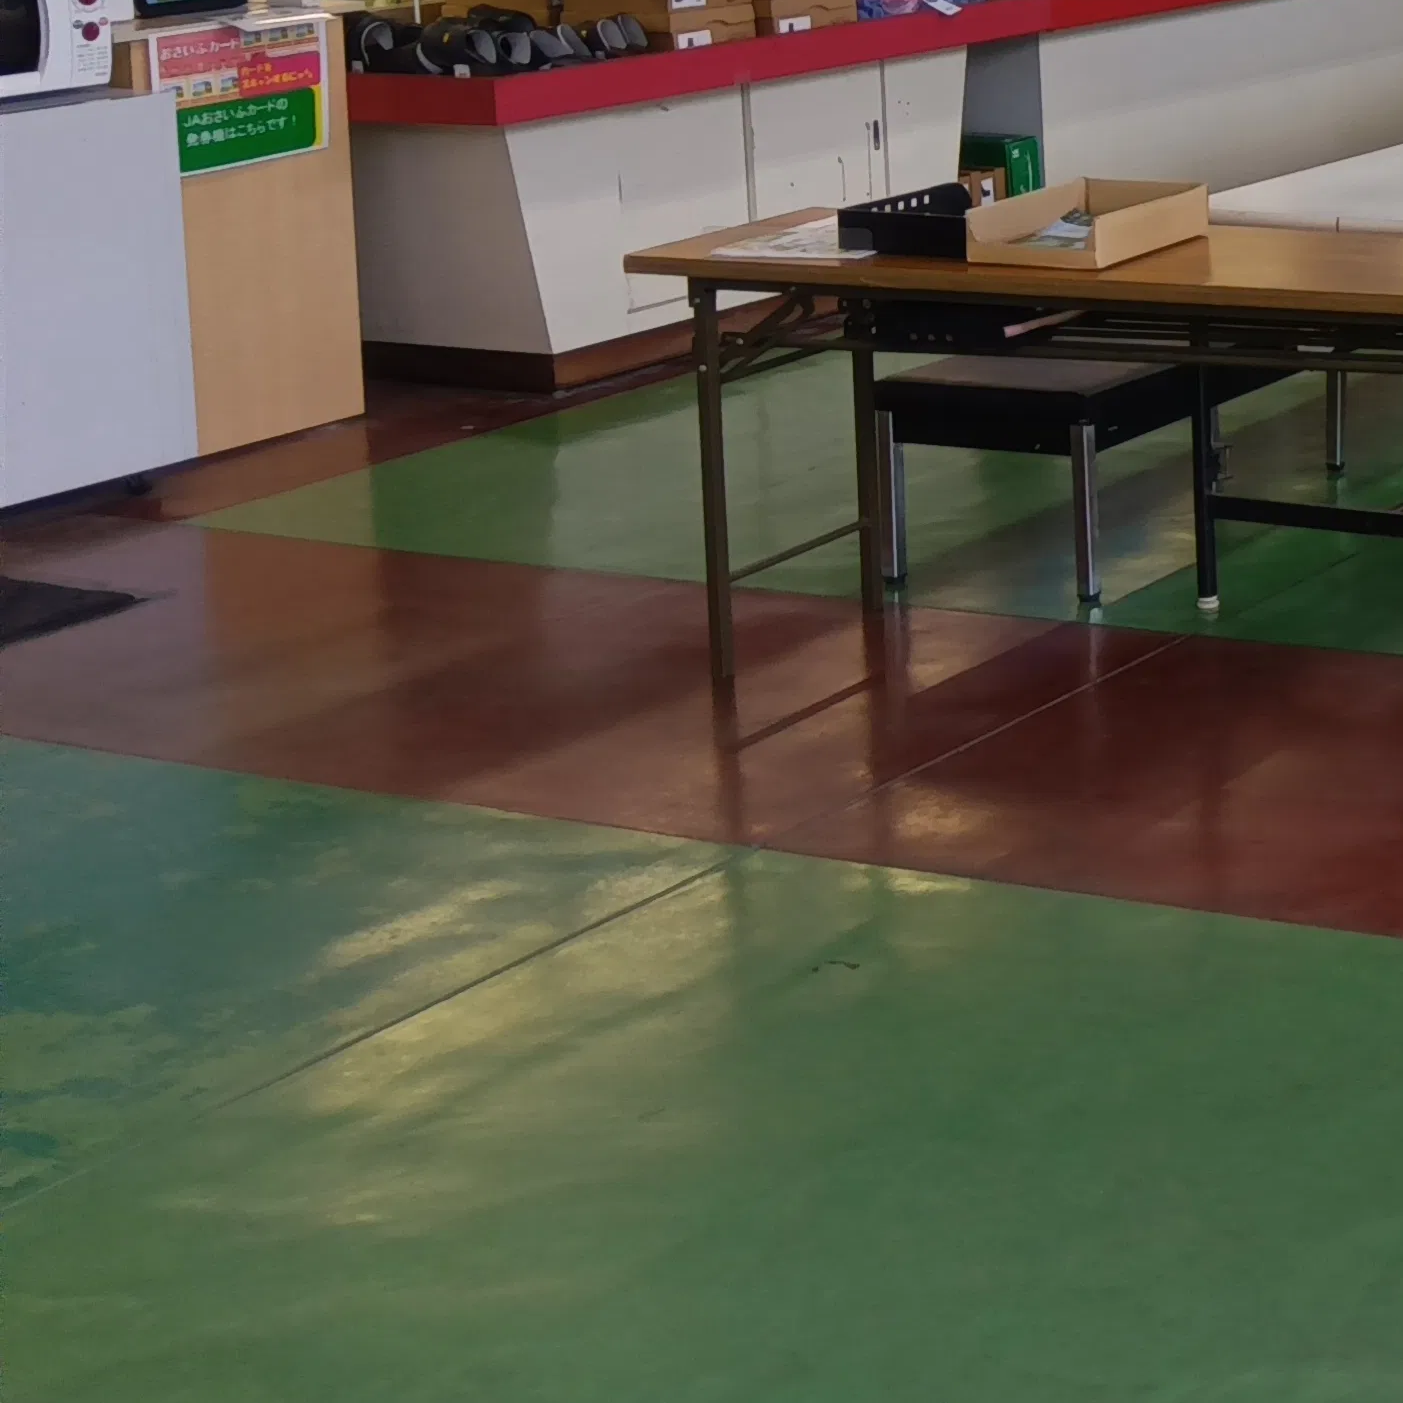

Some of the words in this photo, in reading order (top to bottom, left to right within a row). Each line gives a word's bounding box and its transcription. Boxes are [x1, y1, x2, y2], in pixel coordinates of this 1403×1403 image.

[160, 39, 241, 61] おさいふカード
[184, 98, 289, 128] JAおさいふカードの
